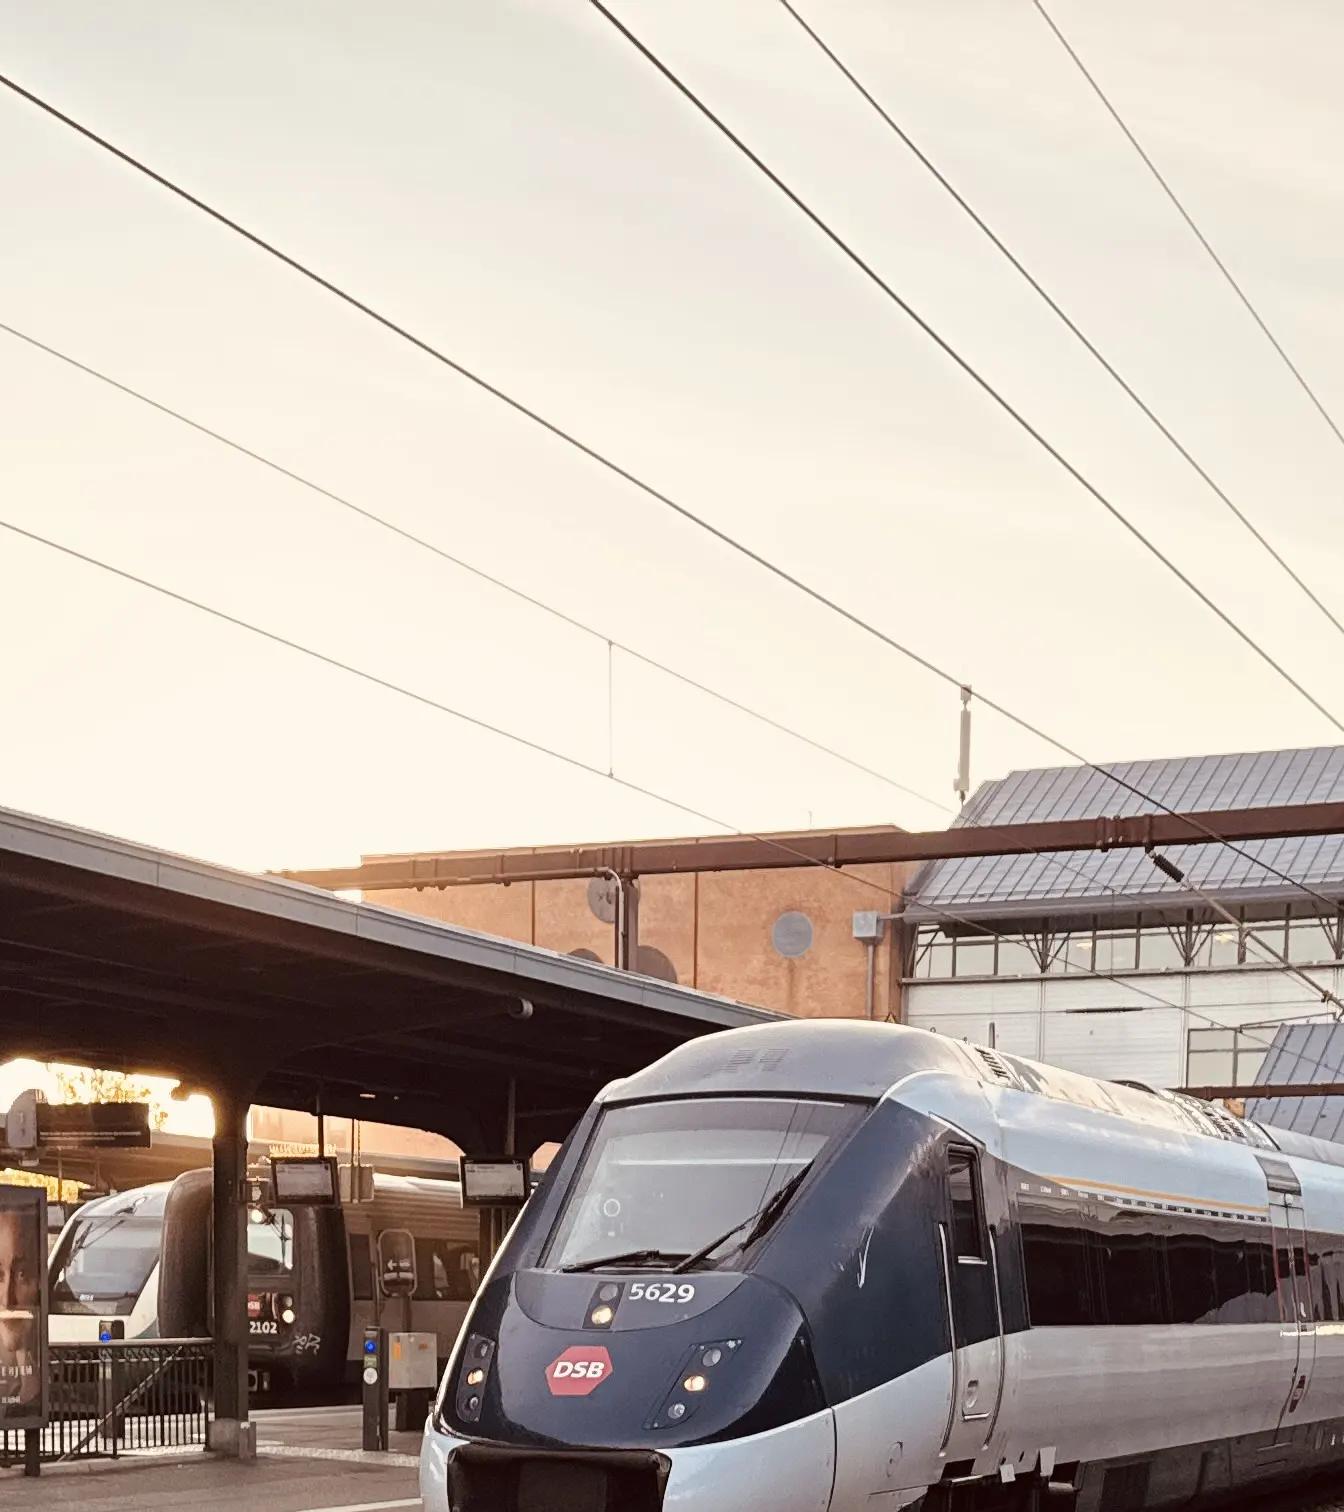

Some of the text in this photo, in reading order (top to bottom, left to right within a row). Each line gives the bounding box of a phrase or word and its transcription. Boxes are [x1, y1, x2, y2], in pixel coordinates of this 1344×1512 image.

[628, 1282, 695, 1303] 5629
[249, 1320, 278, 1334] 2102
[8, 1365, 33, 1378] HJEM
[553, 1361, 605, 1378] DSB
